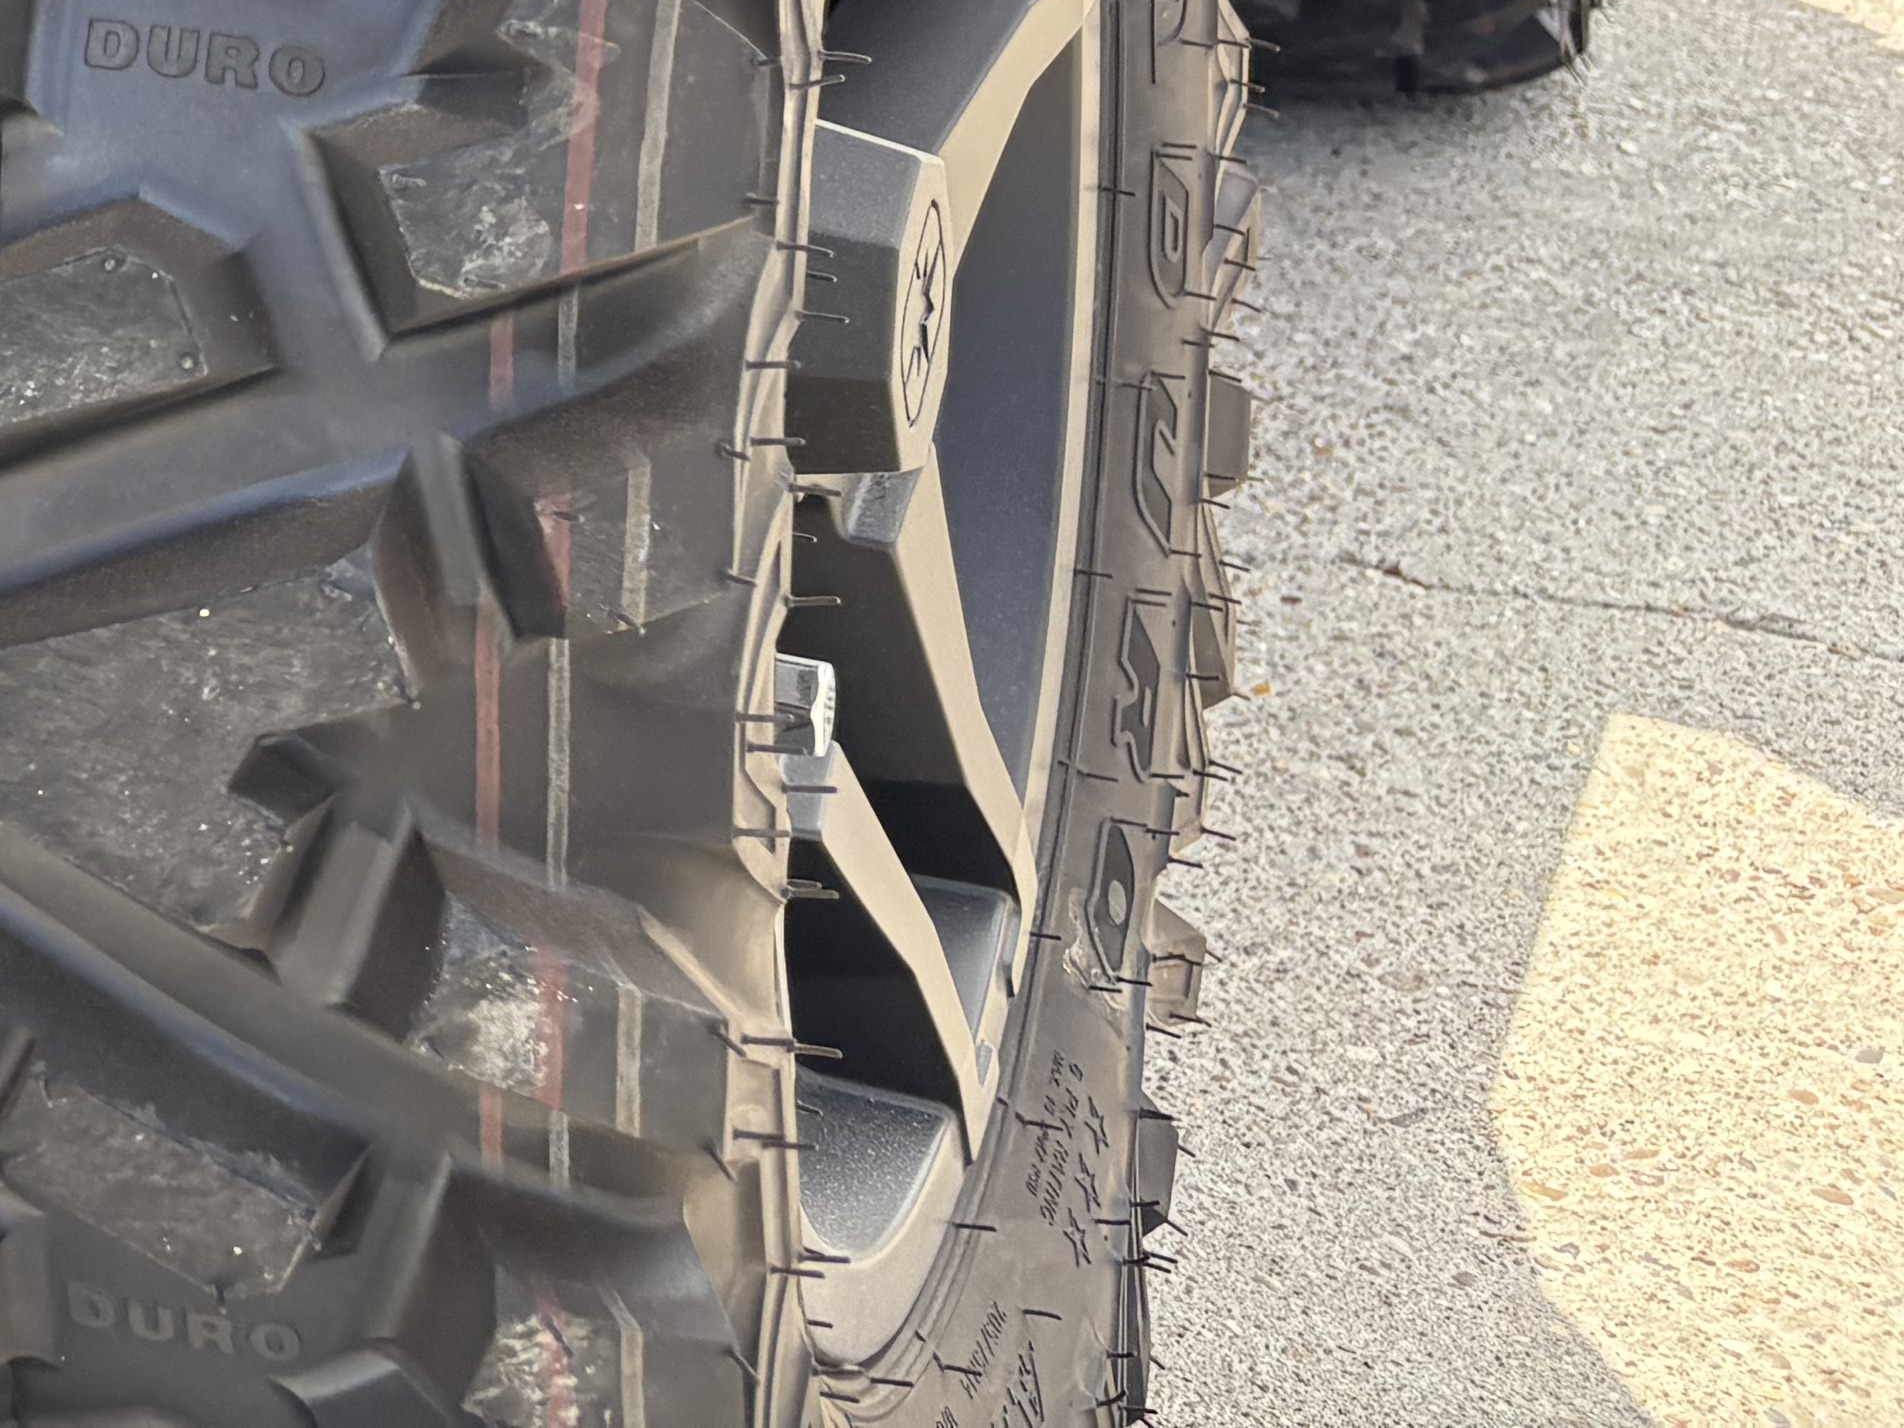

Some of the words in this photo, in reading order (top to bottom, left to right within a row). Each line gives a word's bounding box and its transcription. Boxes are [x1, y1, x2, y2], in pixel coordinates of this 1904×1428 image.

[83, 17, 326, 96] DURO
[1086, 149, 1190, 982] DURO
[66, 1279, 303, 1361] DURO
